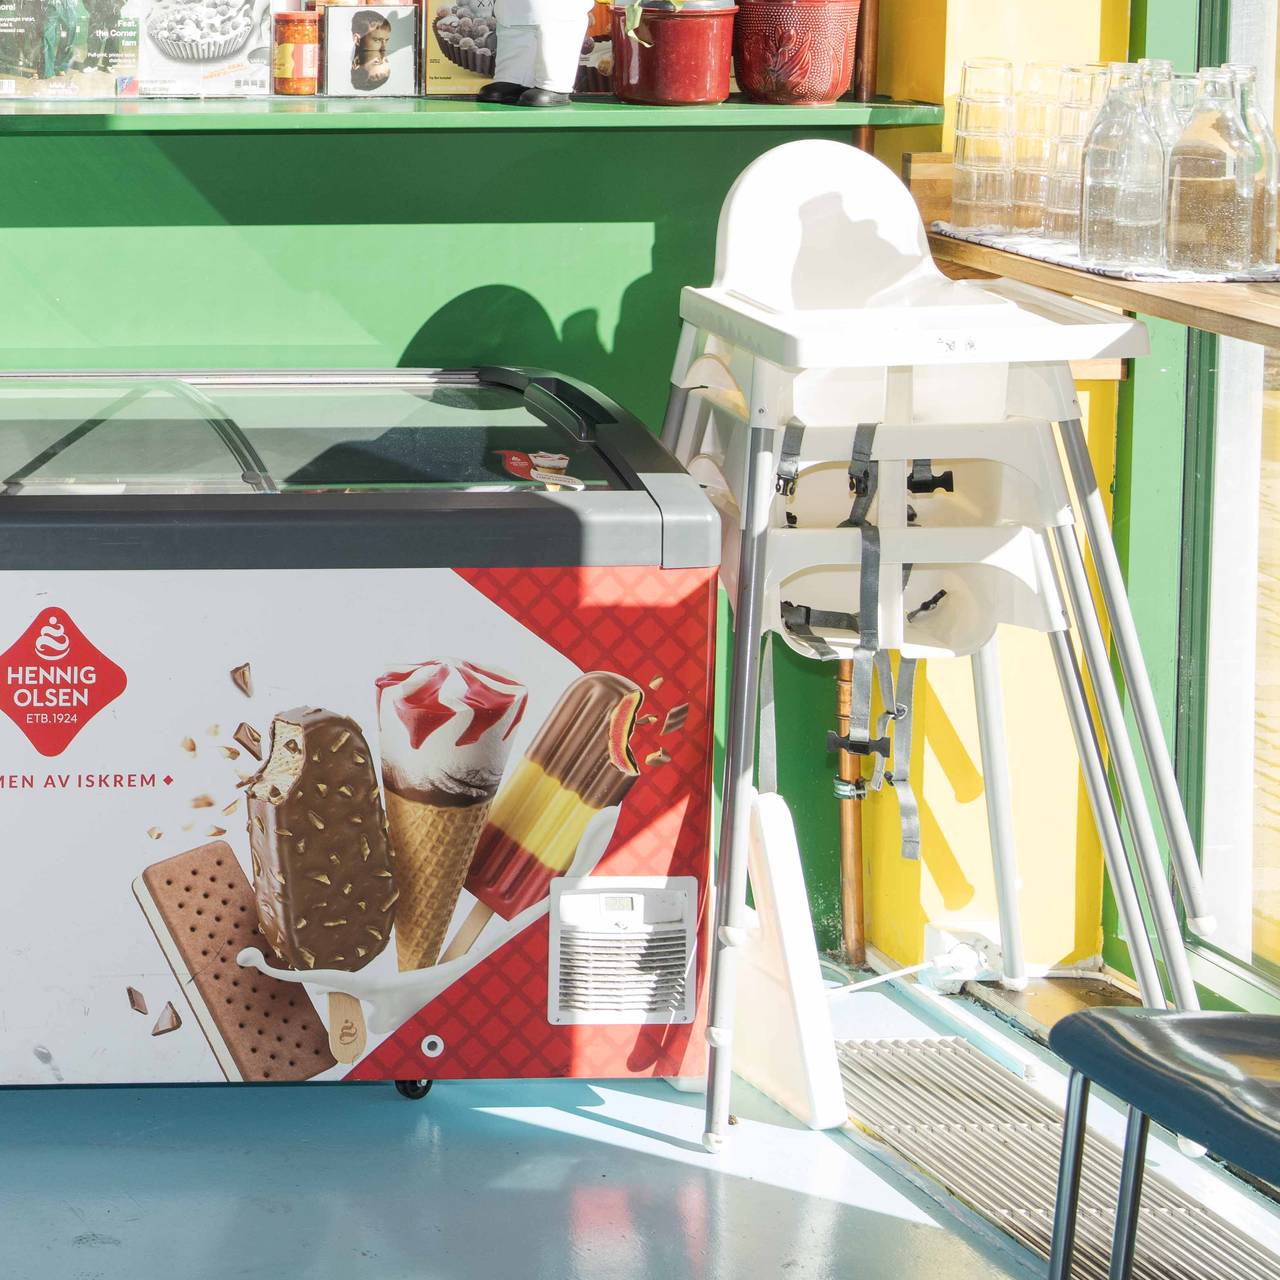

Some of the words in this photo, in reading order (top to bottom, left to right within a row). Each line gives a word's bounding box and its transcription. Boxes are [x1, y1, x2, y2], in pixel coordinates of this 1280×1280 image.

[117, 20, 137, 28] Feat.
[95, 29, 109, 38] the
[110, 29, 137, 38] Corner
[121, 39, 137, 47] fam
[6, 665, 97, 685] HENNIG
[13, 687, 89, 708] OLSEN
[26, 713, 78, 724] ETB.1924
[43, 774, 71, 788] AV
[77, 773, 157, 788] ISKREM
